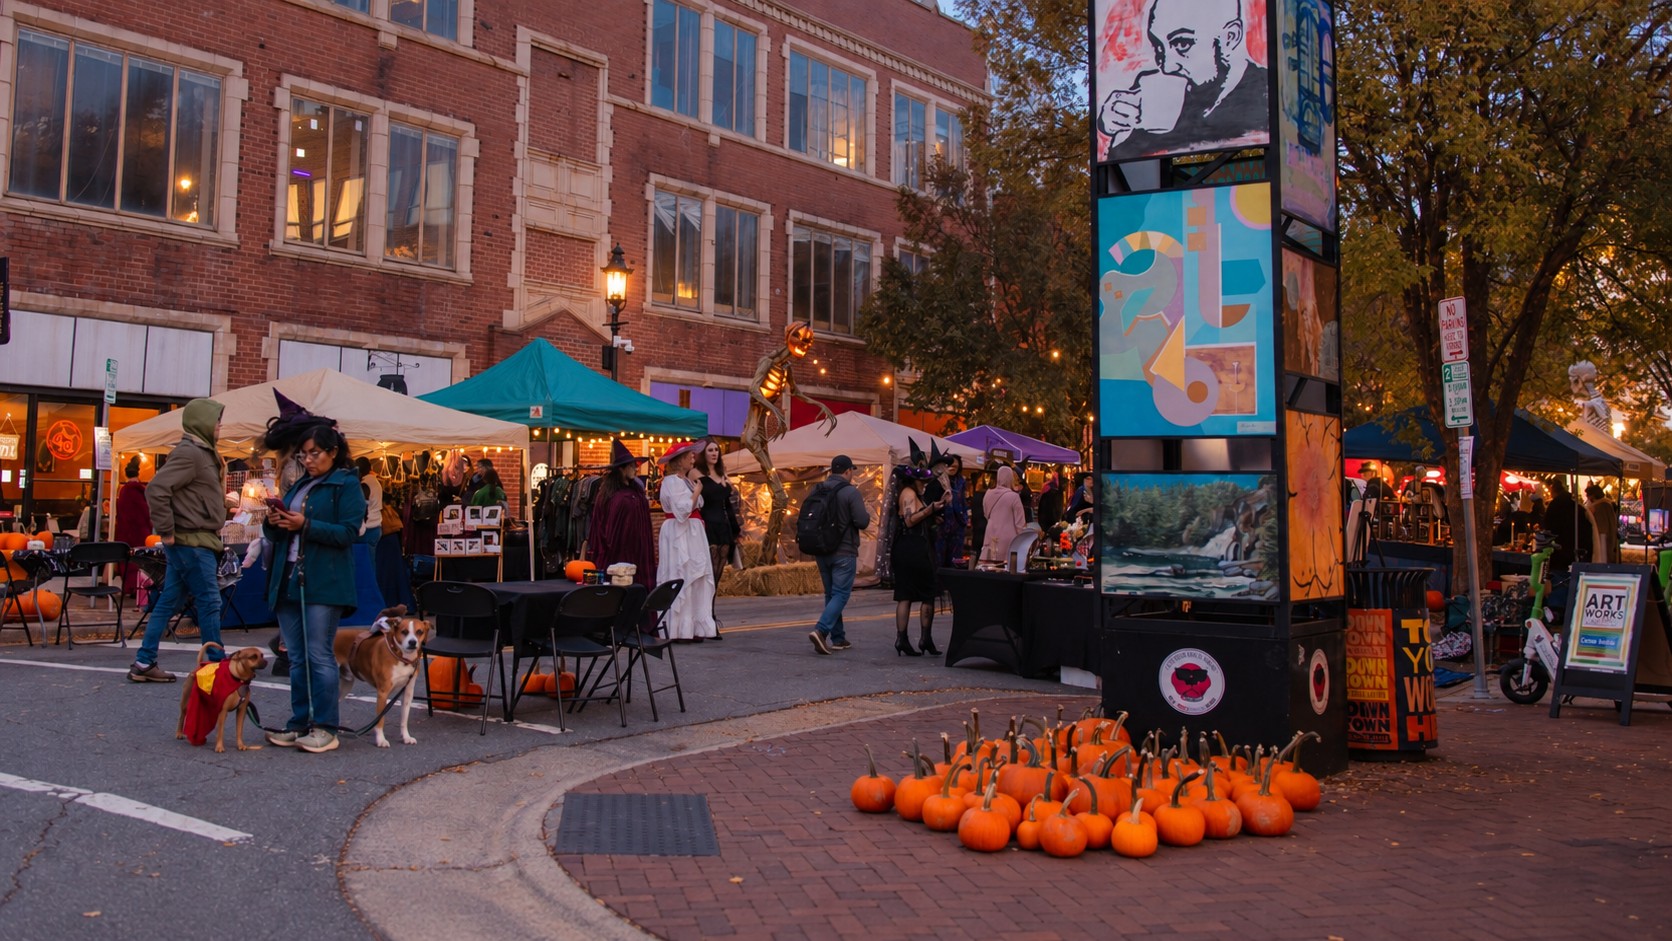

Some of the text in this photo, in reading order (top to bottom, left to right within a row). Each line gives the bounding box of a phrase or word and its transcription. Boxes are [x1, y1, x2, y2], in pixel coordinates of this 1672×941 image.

[1446, 303, 1456, 316] NO
[1441, 316, 1464, 330] PARKING
[1444, 368, 1451, 380] 2
[1586, 593, 1626, 610] ART
[1585, 609, 1624, 620] WORKS
